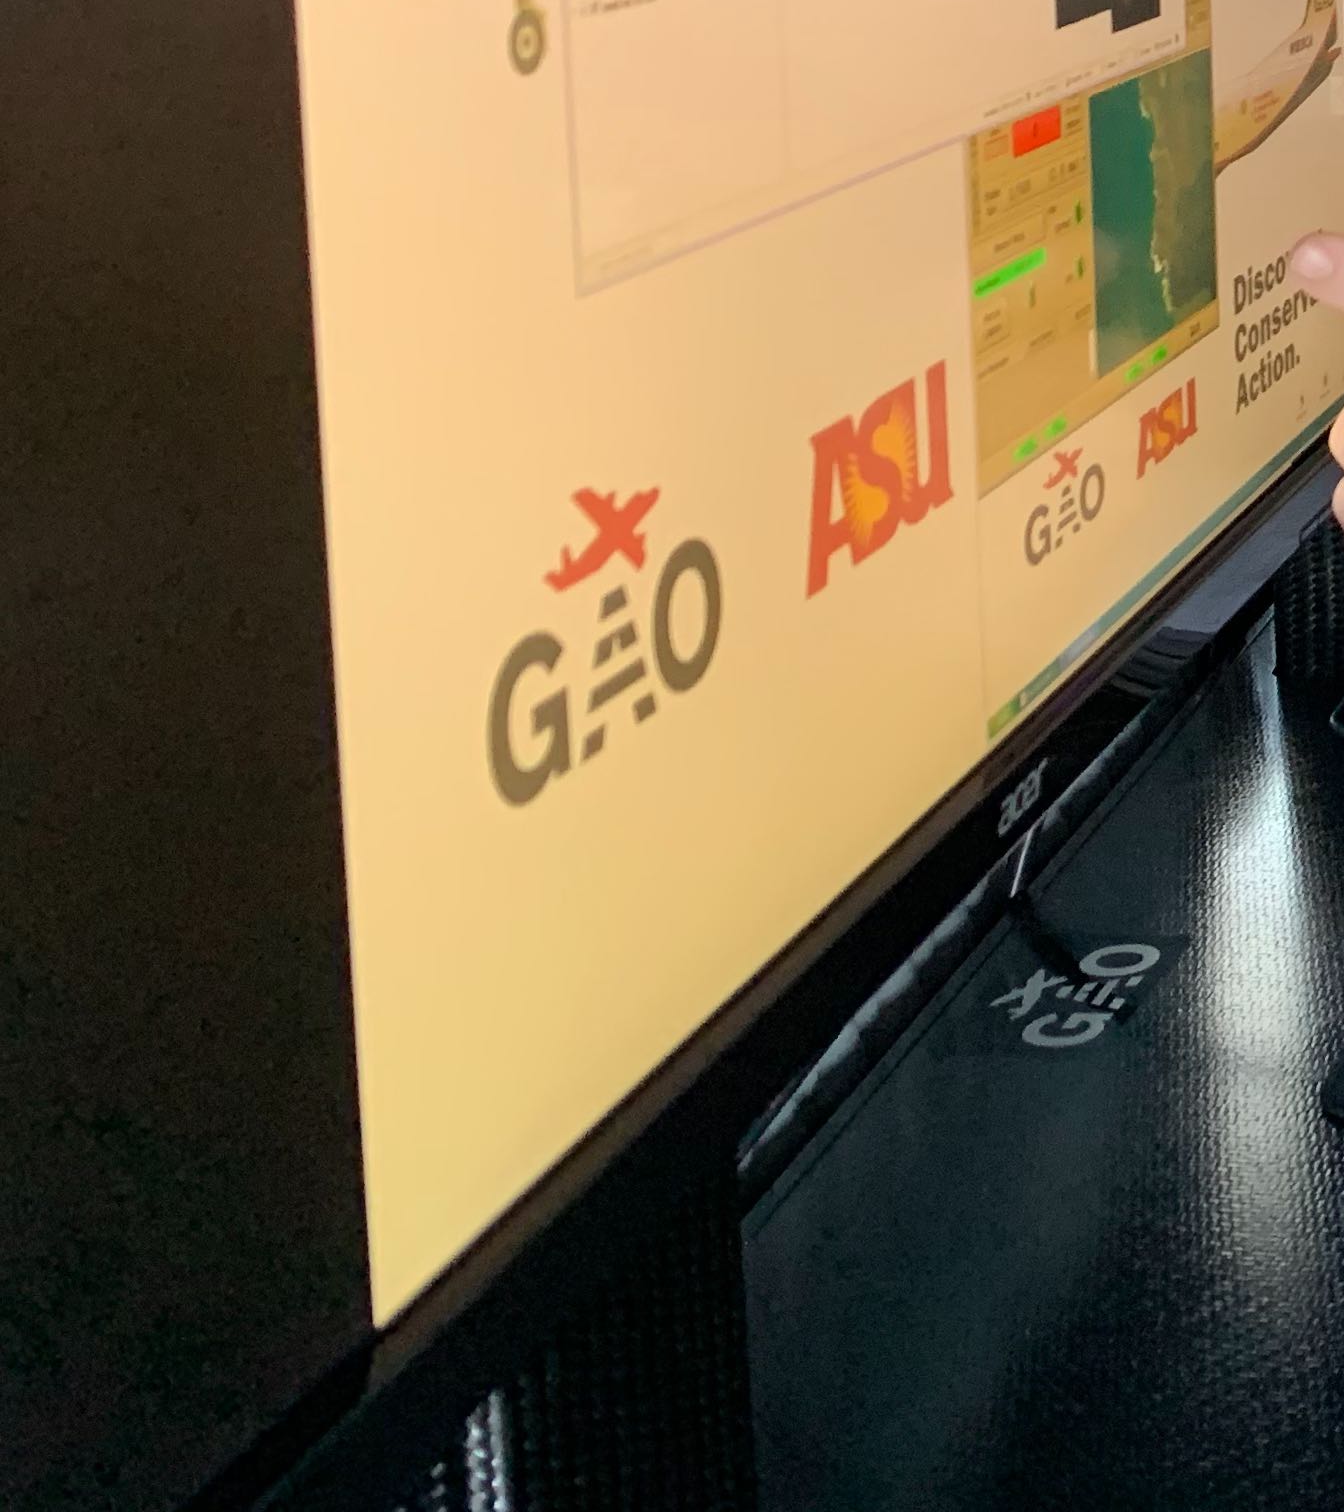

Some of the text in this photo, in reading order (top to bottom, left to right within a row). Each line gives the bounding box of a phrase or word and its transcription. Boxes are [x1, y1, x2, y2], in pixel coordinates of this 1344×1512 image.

[1233, 250, 1289, 315] Disco
[1235, 344, 1300, 415] Action.
[1136, 379, 1198, 480] ASU
[806, 359, 953, 600] ASU
